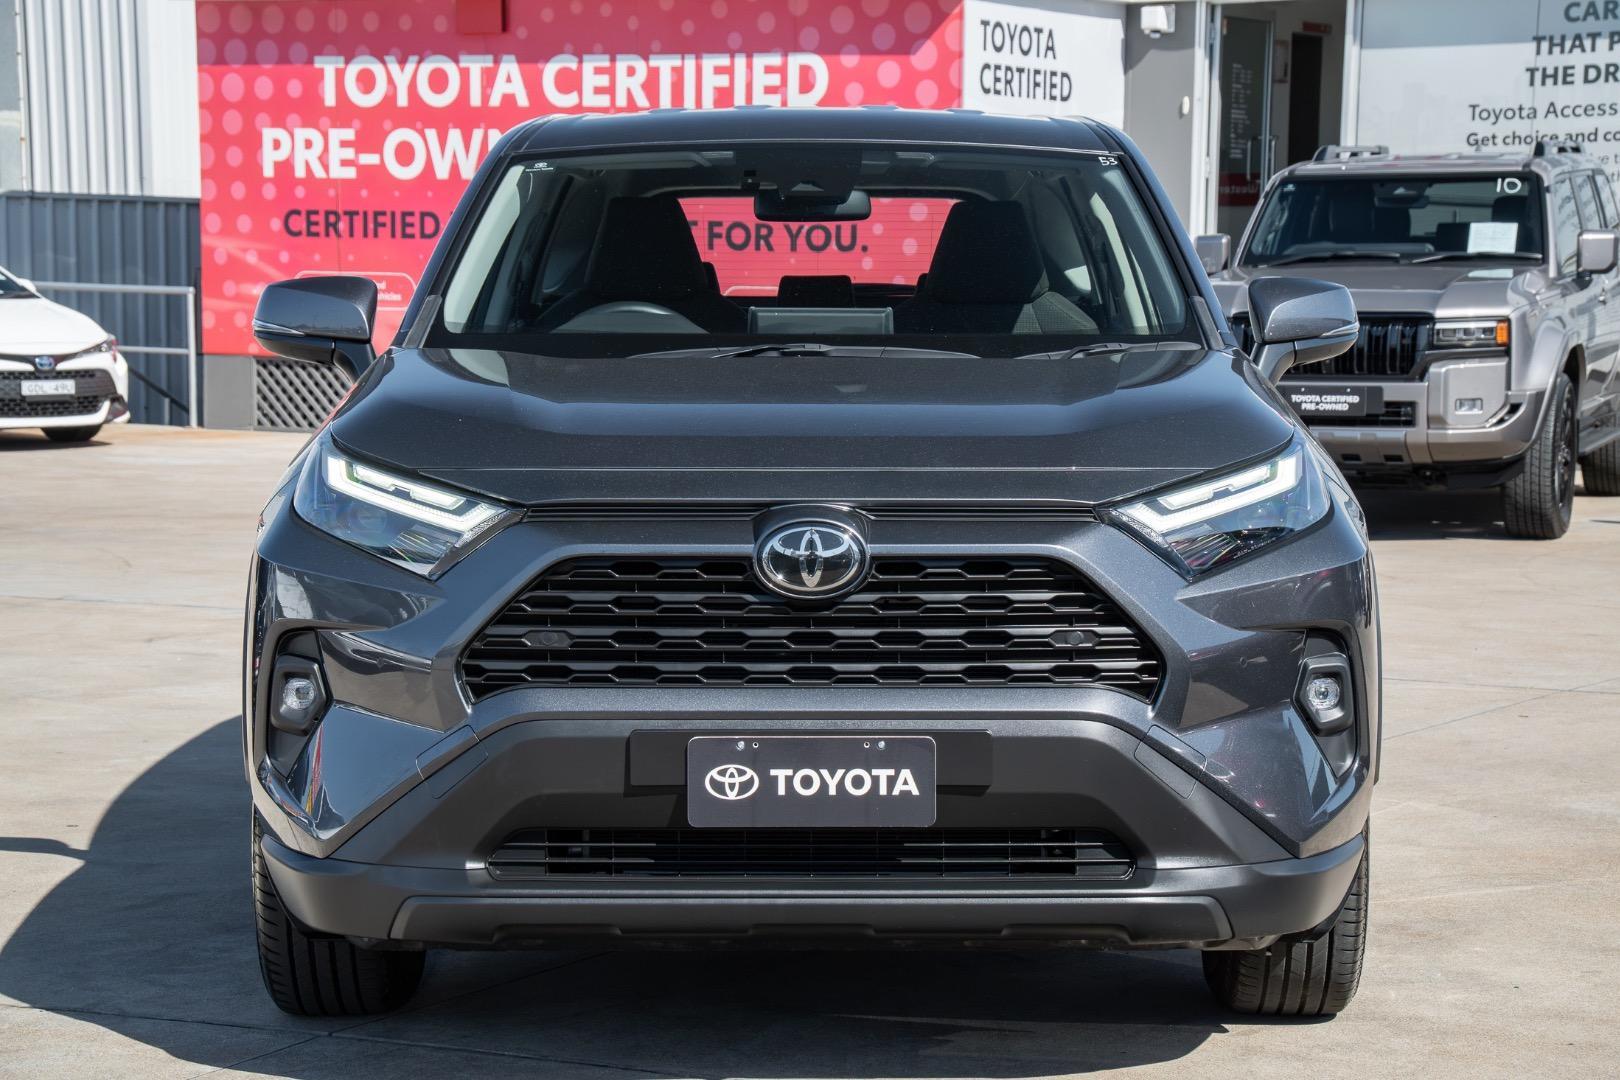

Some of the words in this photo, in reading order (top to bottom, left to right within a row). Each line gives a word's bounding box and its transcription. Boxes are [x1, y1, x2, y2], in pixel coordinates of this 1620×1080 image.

[1563, 0, 1619, 23] CAR
[979, 18, 1057, 60] TOYOTA
[1532, 31, 1602, 56] THAT
[313, 54, 530, 108] TOYOTA
[541, 52, 829, 109] CERTIFIED
[979, 62, 1073, 103] CERTIFIED
[1525, 64, 1576, 87] THE
[1468, 103, 1538, 126] Toyota
[1544, 101, 1619, 119] Access
[1466, 131, 1498, 147] Get
[1098, 156, 1118, 166] 53
[1496, 177, 1522, 194] 10
[283, 209, 441, 240] CERTIFIED
[707, 220, 775, 252] FOR
[783, 222, 870, 254] YOU.
[1291, 394, 1320, 403] TOYOTA
[1321, 395, 1360, 404] CERTIFIED
[1301, 403, 1349, 411] PRE-OWNED
[769, 768, 920, 796] TOYOTA
